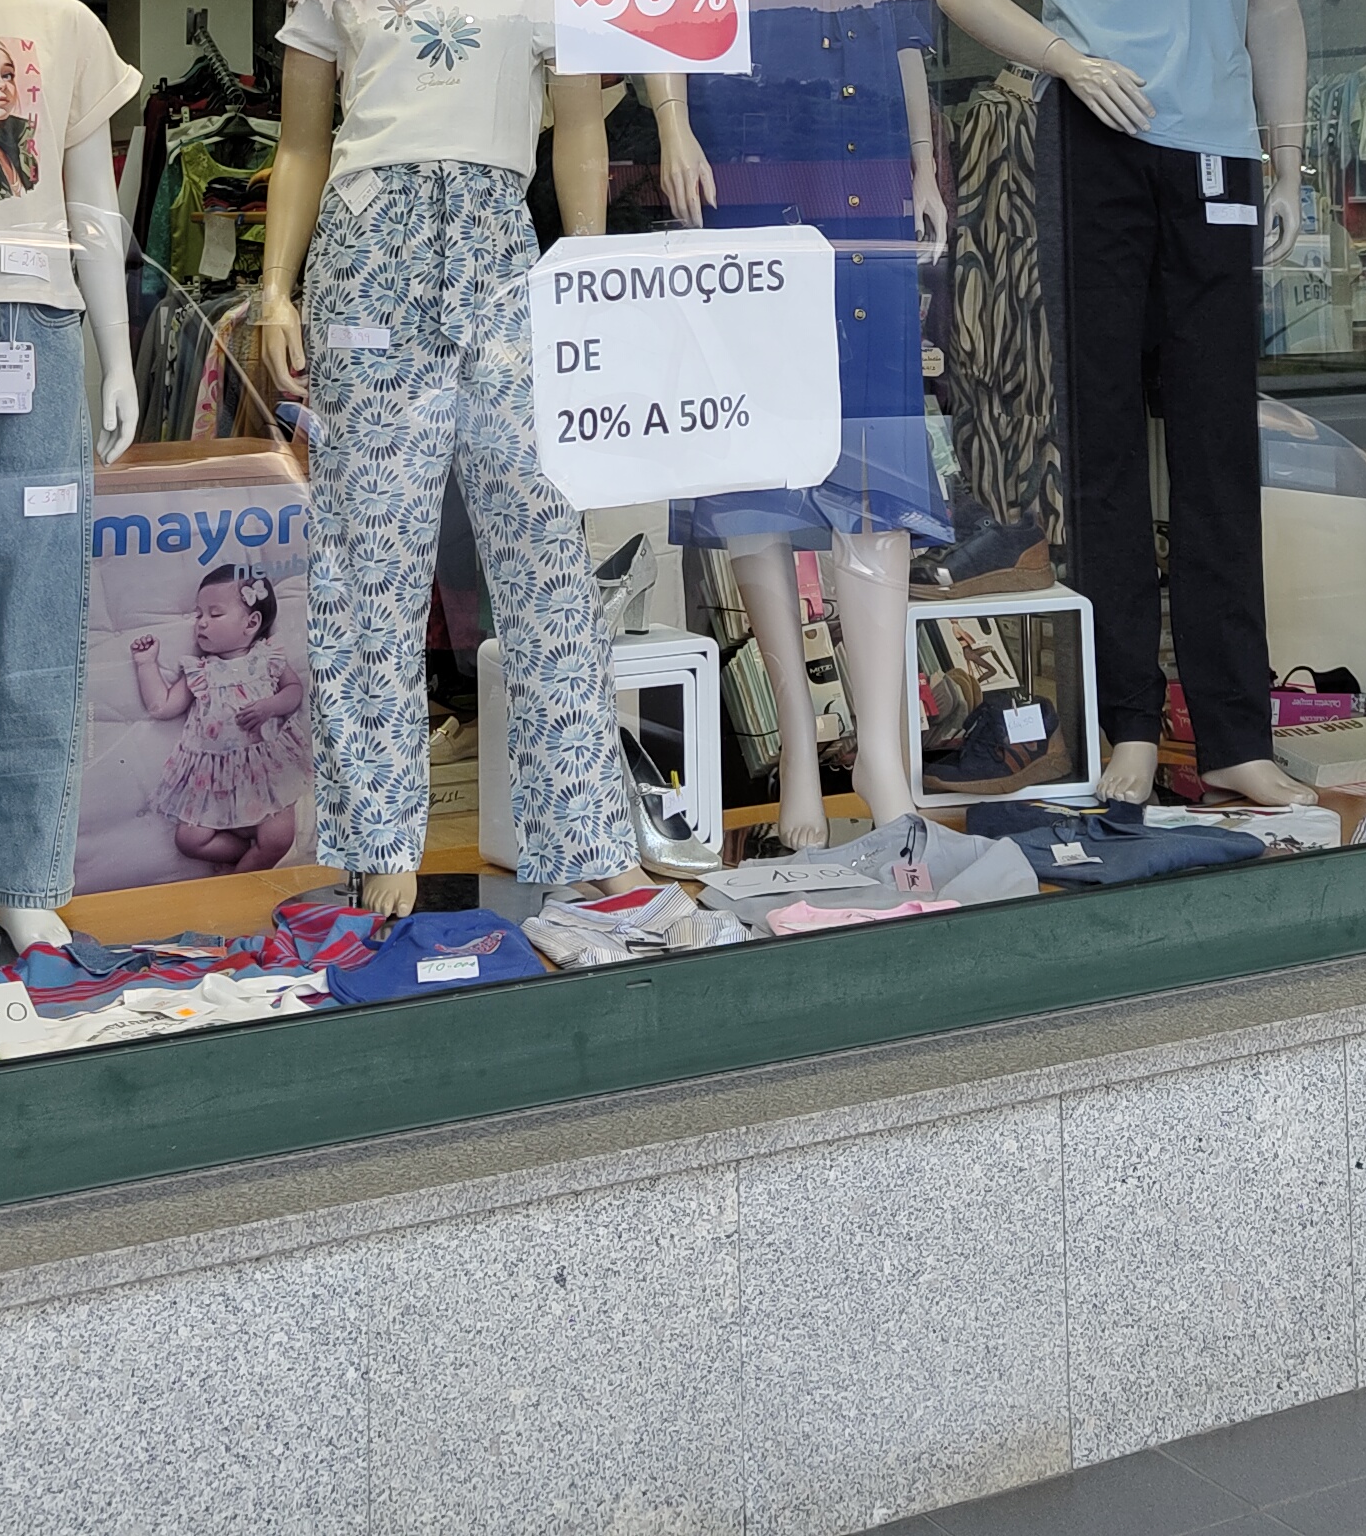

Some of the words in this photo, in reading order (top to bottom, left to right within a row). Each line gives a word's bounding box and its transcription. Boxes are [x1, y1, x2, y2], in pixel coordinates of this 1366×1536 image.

[554, 253, 785, 304] PROMOÇÕES
[556, 339, 601, 374] DE
[557, 403, 631, 444] 20%
[643, 402, 670, 436] A
[680, 394, 750, 432] 50%
[92, 503, 308, 566] mayor
[234, 553, 306, 580] newb
[1273, 725, 1318, 738] FILIP
[1319, 719, 1364, 734] ANA
